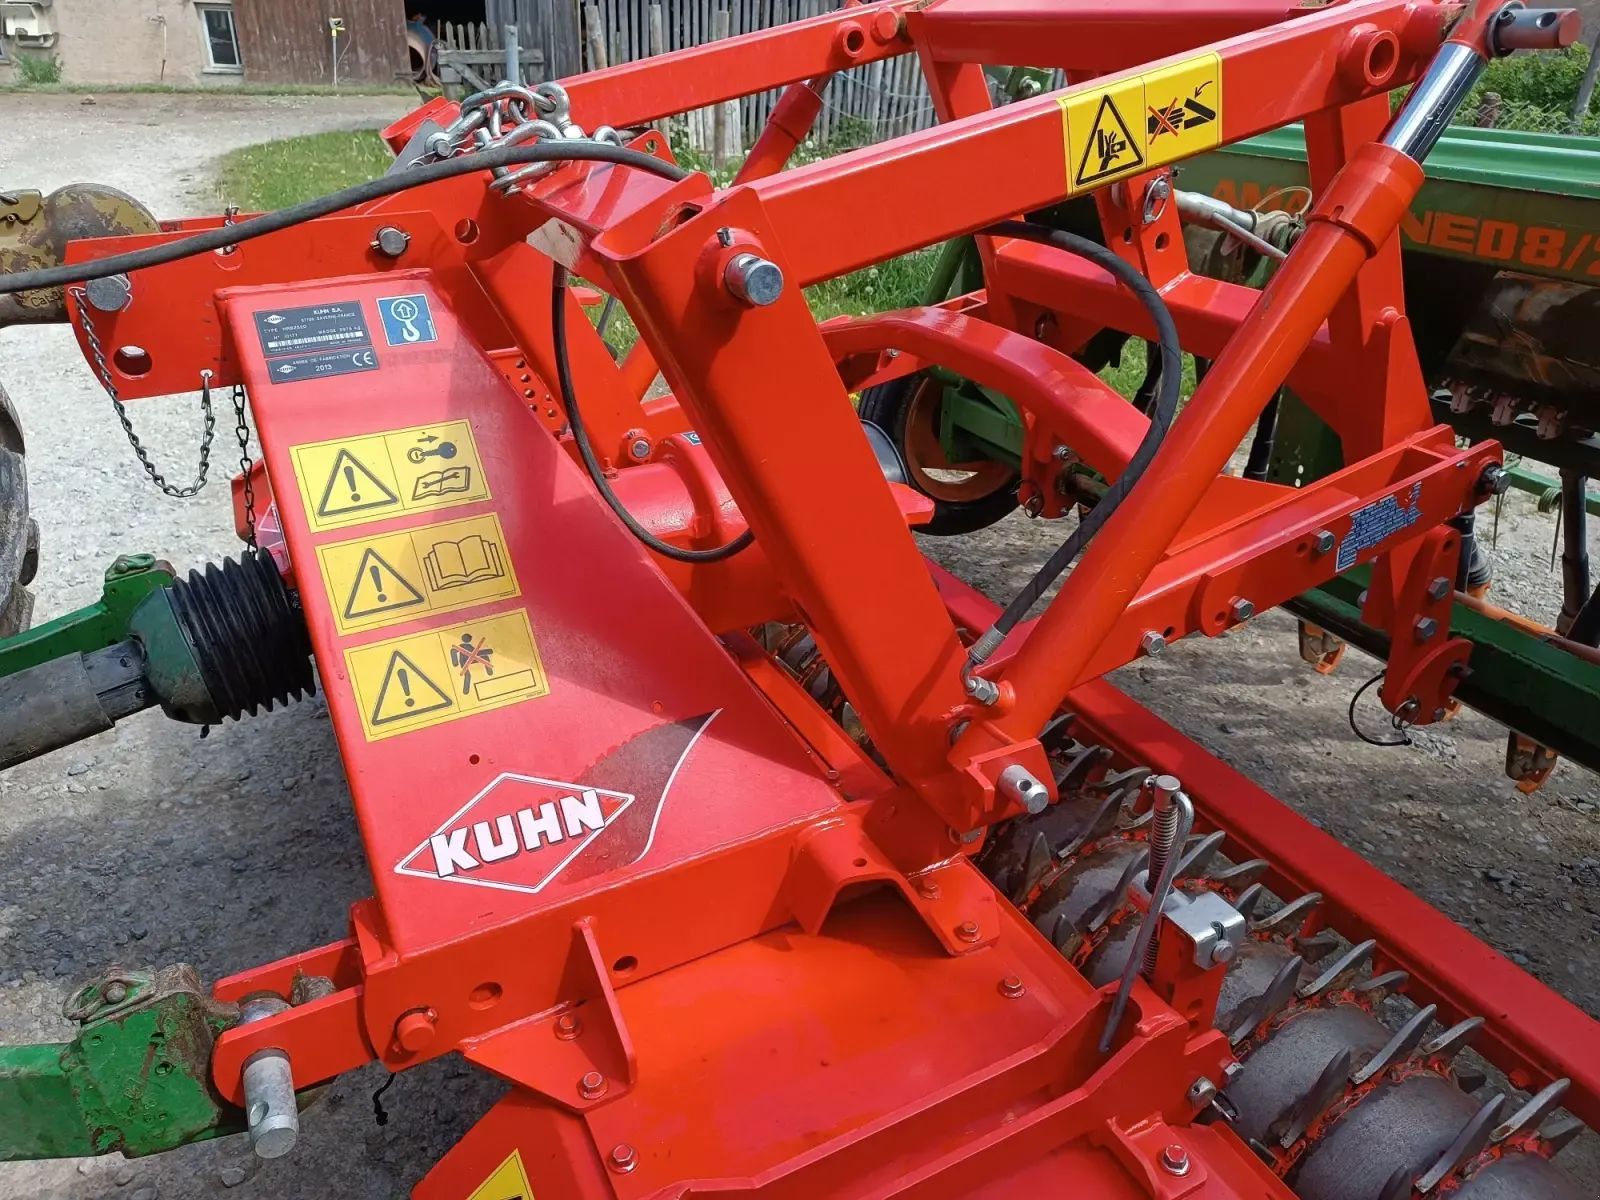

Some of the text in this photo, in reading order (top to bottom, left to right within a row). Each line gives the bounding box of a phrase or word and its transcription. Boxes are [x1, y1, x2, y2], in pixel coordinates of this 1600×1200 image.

[313, 308, 330, 316] KUHN
[352, 351, 374, 367] CE
[315, 363, 333, 372] 2013
[429, 788, 606, 879] KUHN
